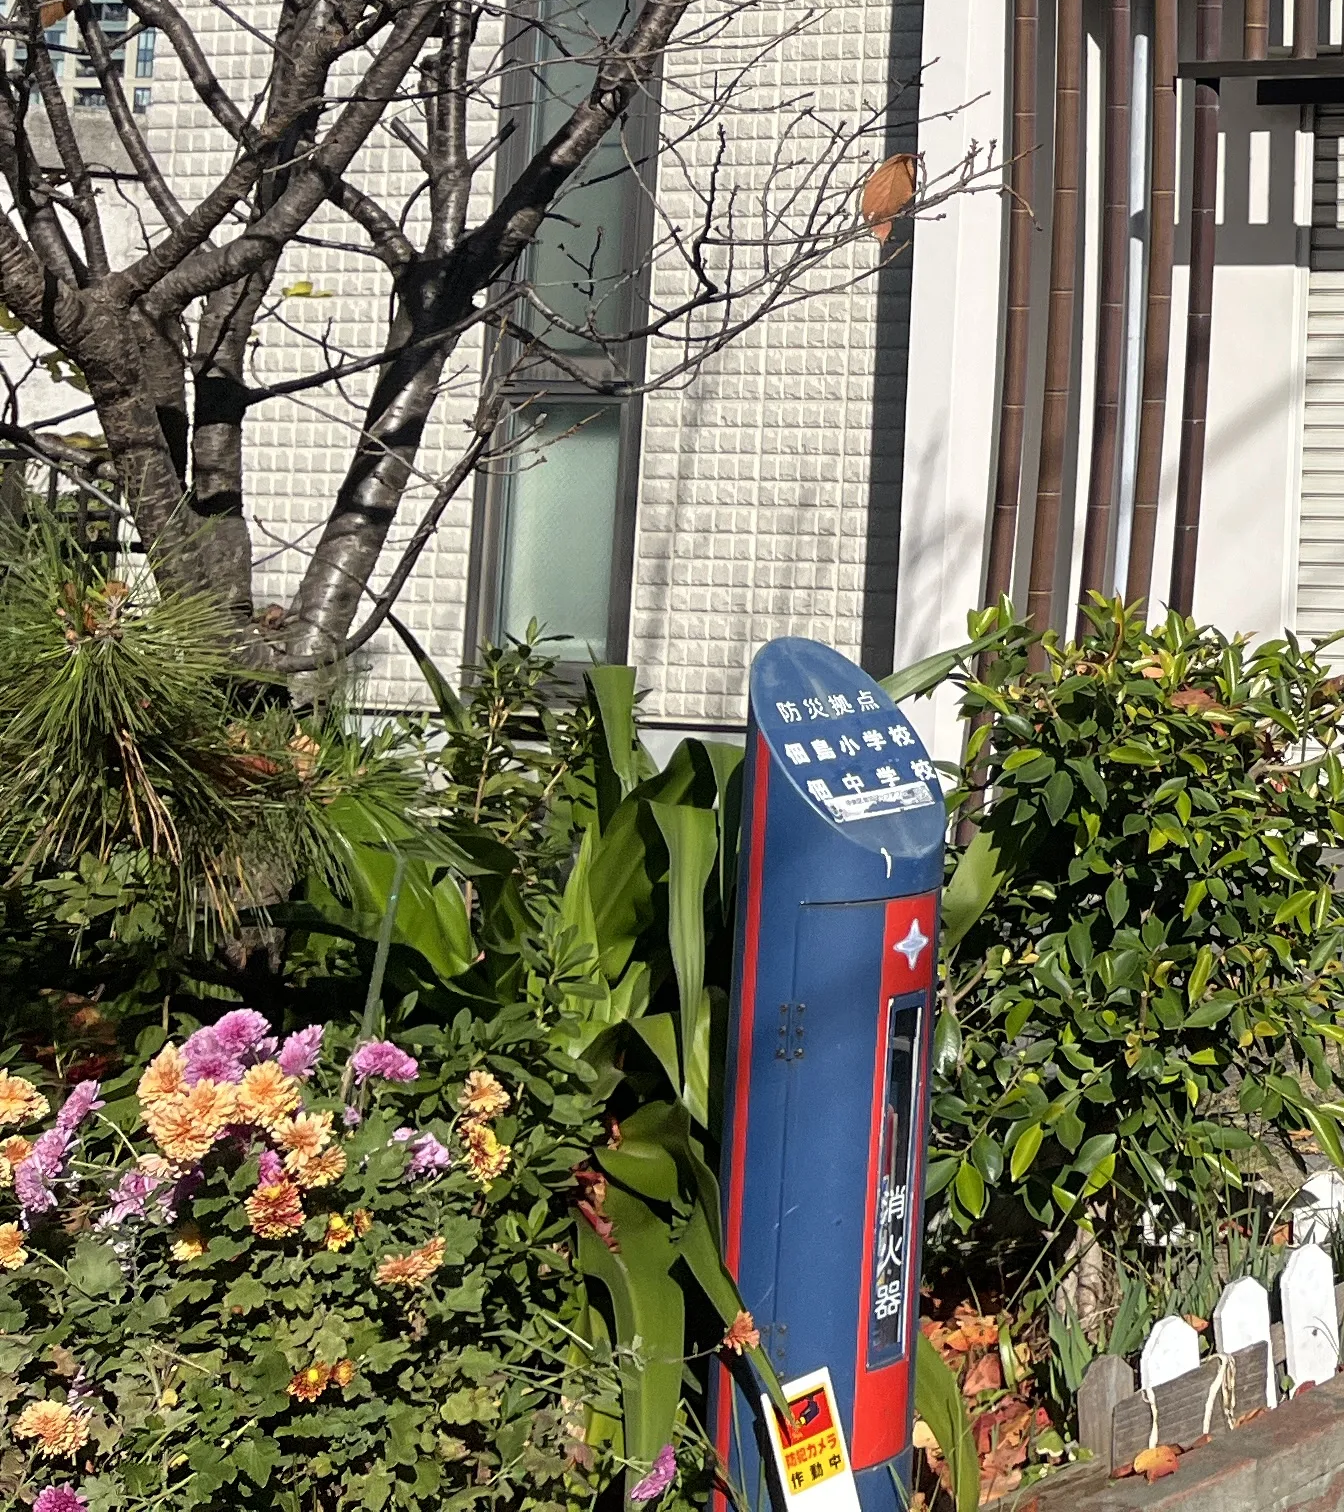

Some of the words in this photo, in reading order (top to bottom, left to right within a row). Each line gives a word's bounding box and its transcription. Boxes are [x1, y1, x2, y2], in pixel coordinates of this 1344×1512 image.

[775, 690, 881, 723] 防災拠点
[784, 724, 916, 766] 佃島小学校
[807, 759, 937, 802] 佃中学校
[874, 1185, 906, 1320] 消火器
[785, 1433, 838, 1470] 防犯カメラ
[791, 1453, 842, 1490] 作動中
